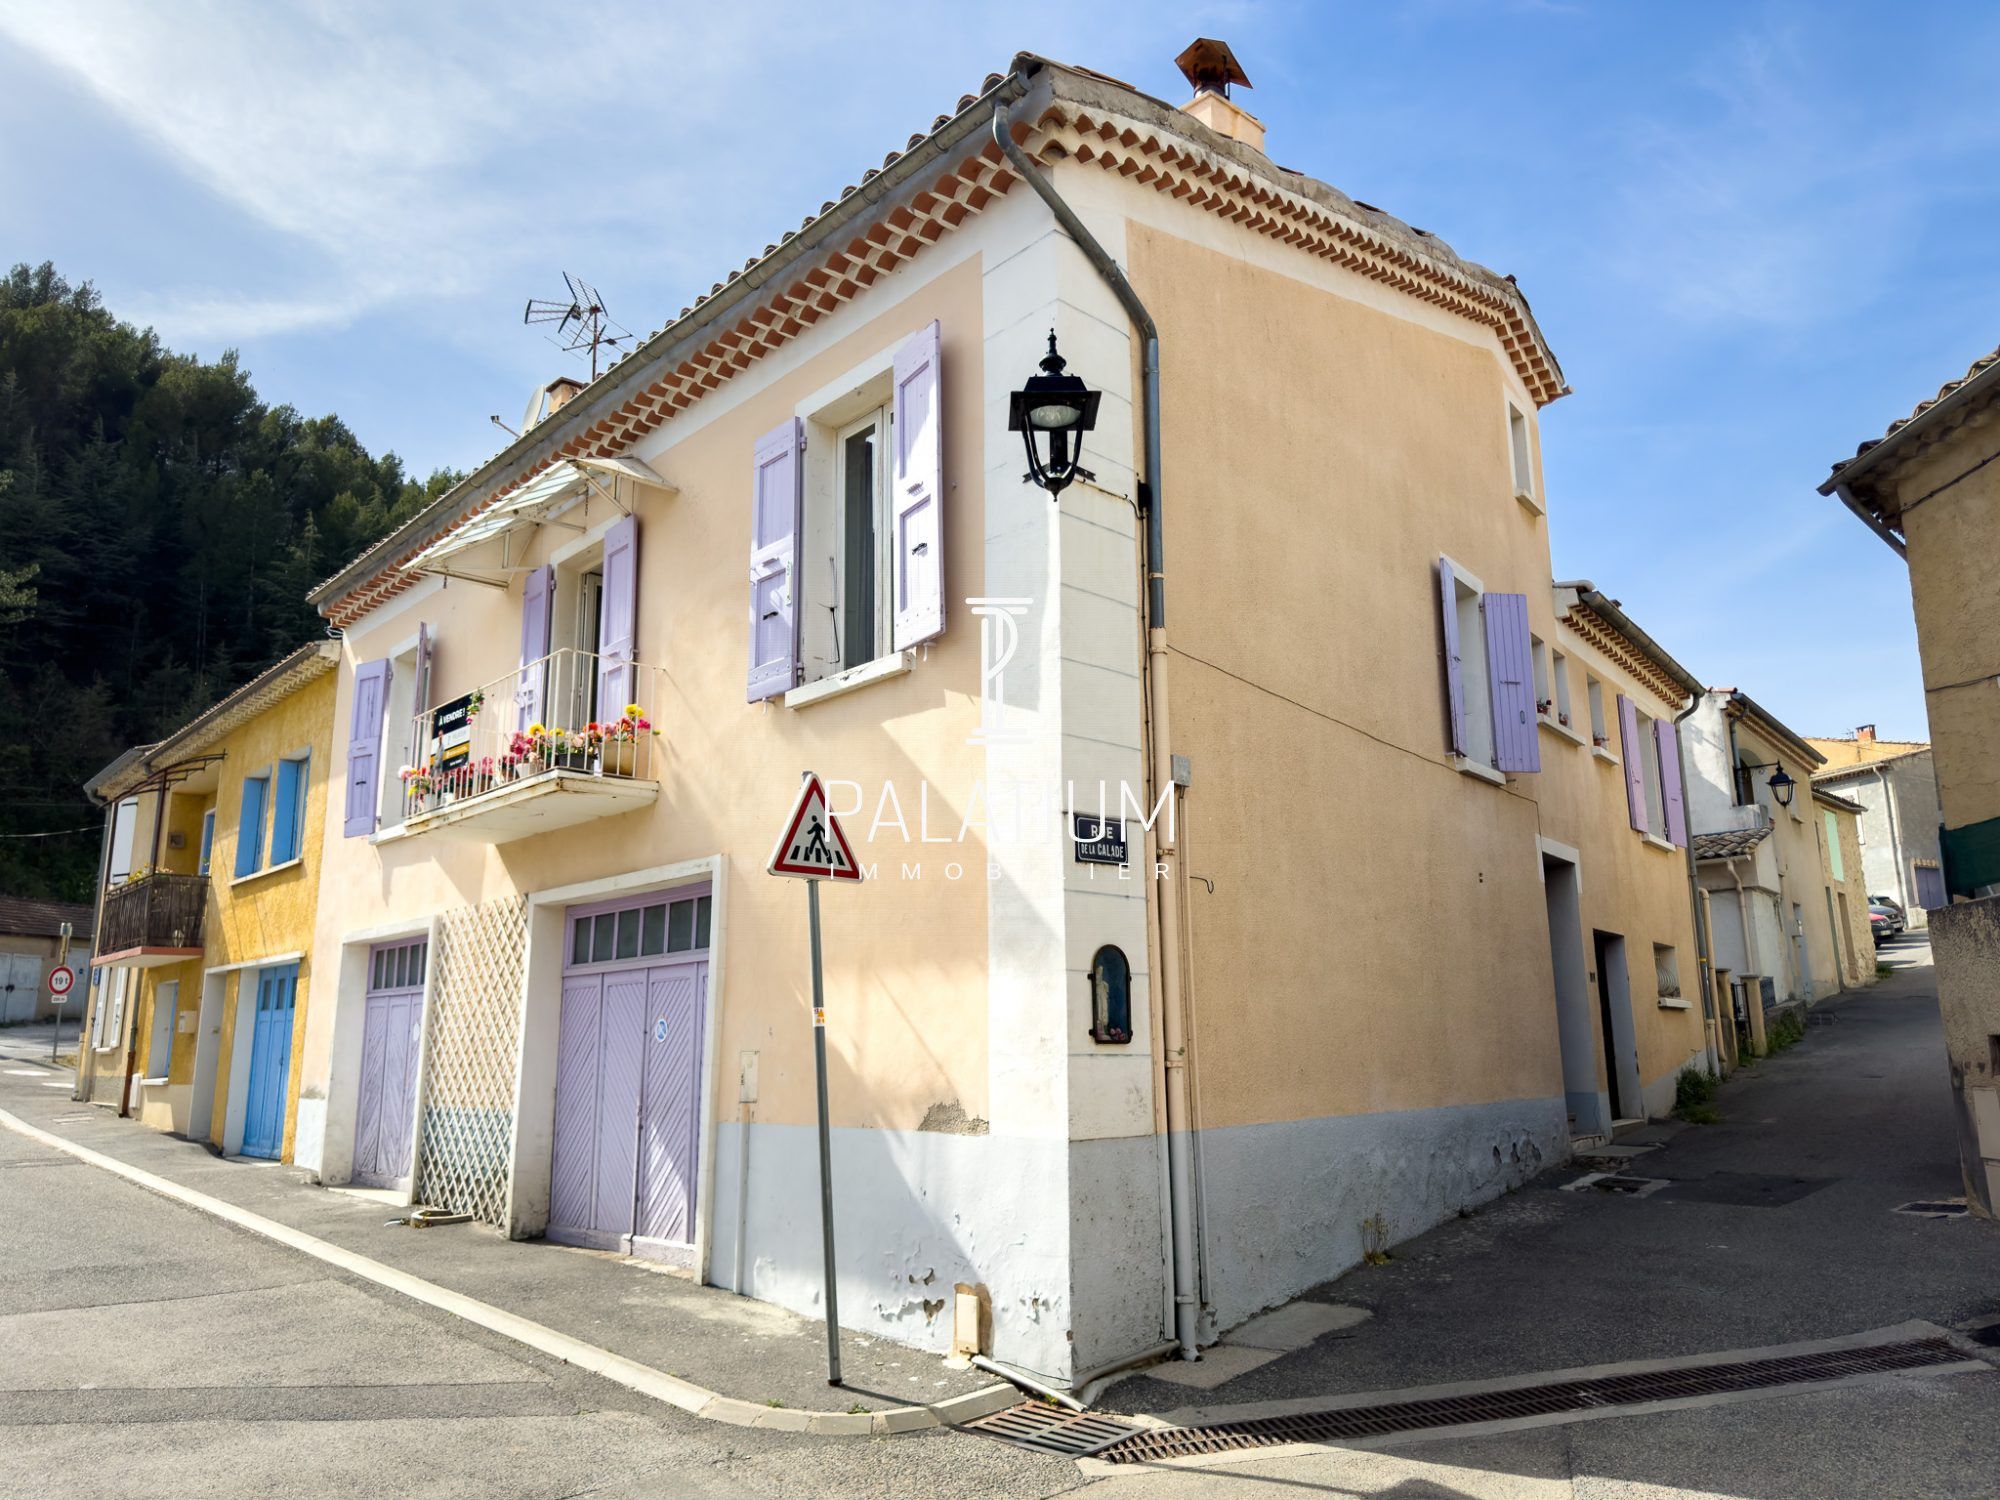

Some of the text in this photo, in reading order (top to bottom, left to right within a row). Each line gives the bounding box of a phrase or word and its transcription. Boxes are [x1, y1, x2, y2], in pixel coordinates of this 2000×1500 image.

[1091, 824, 1114, 839] RE
[1081, 843, 1124, 858] DE LA CALADE
[55, 976, 64, 985] 19
